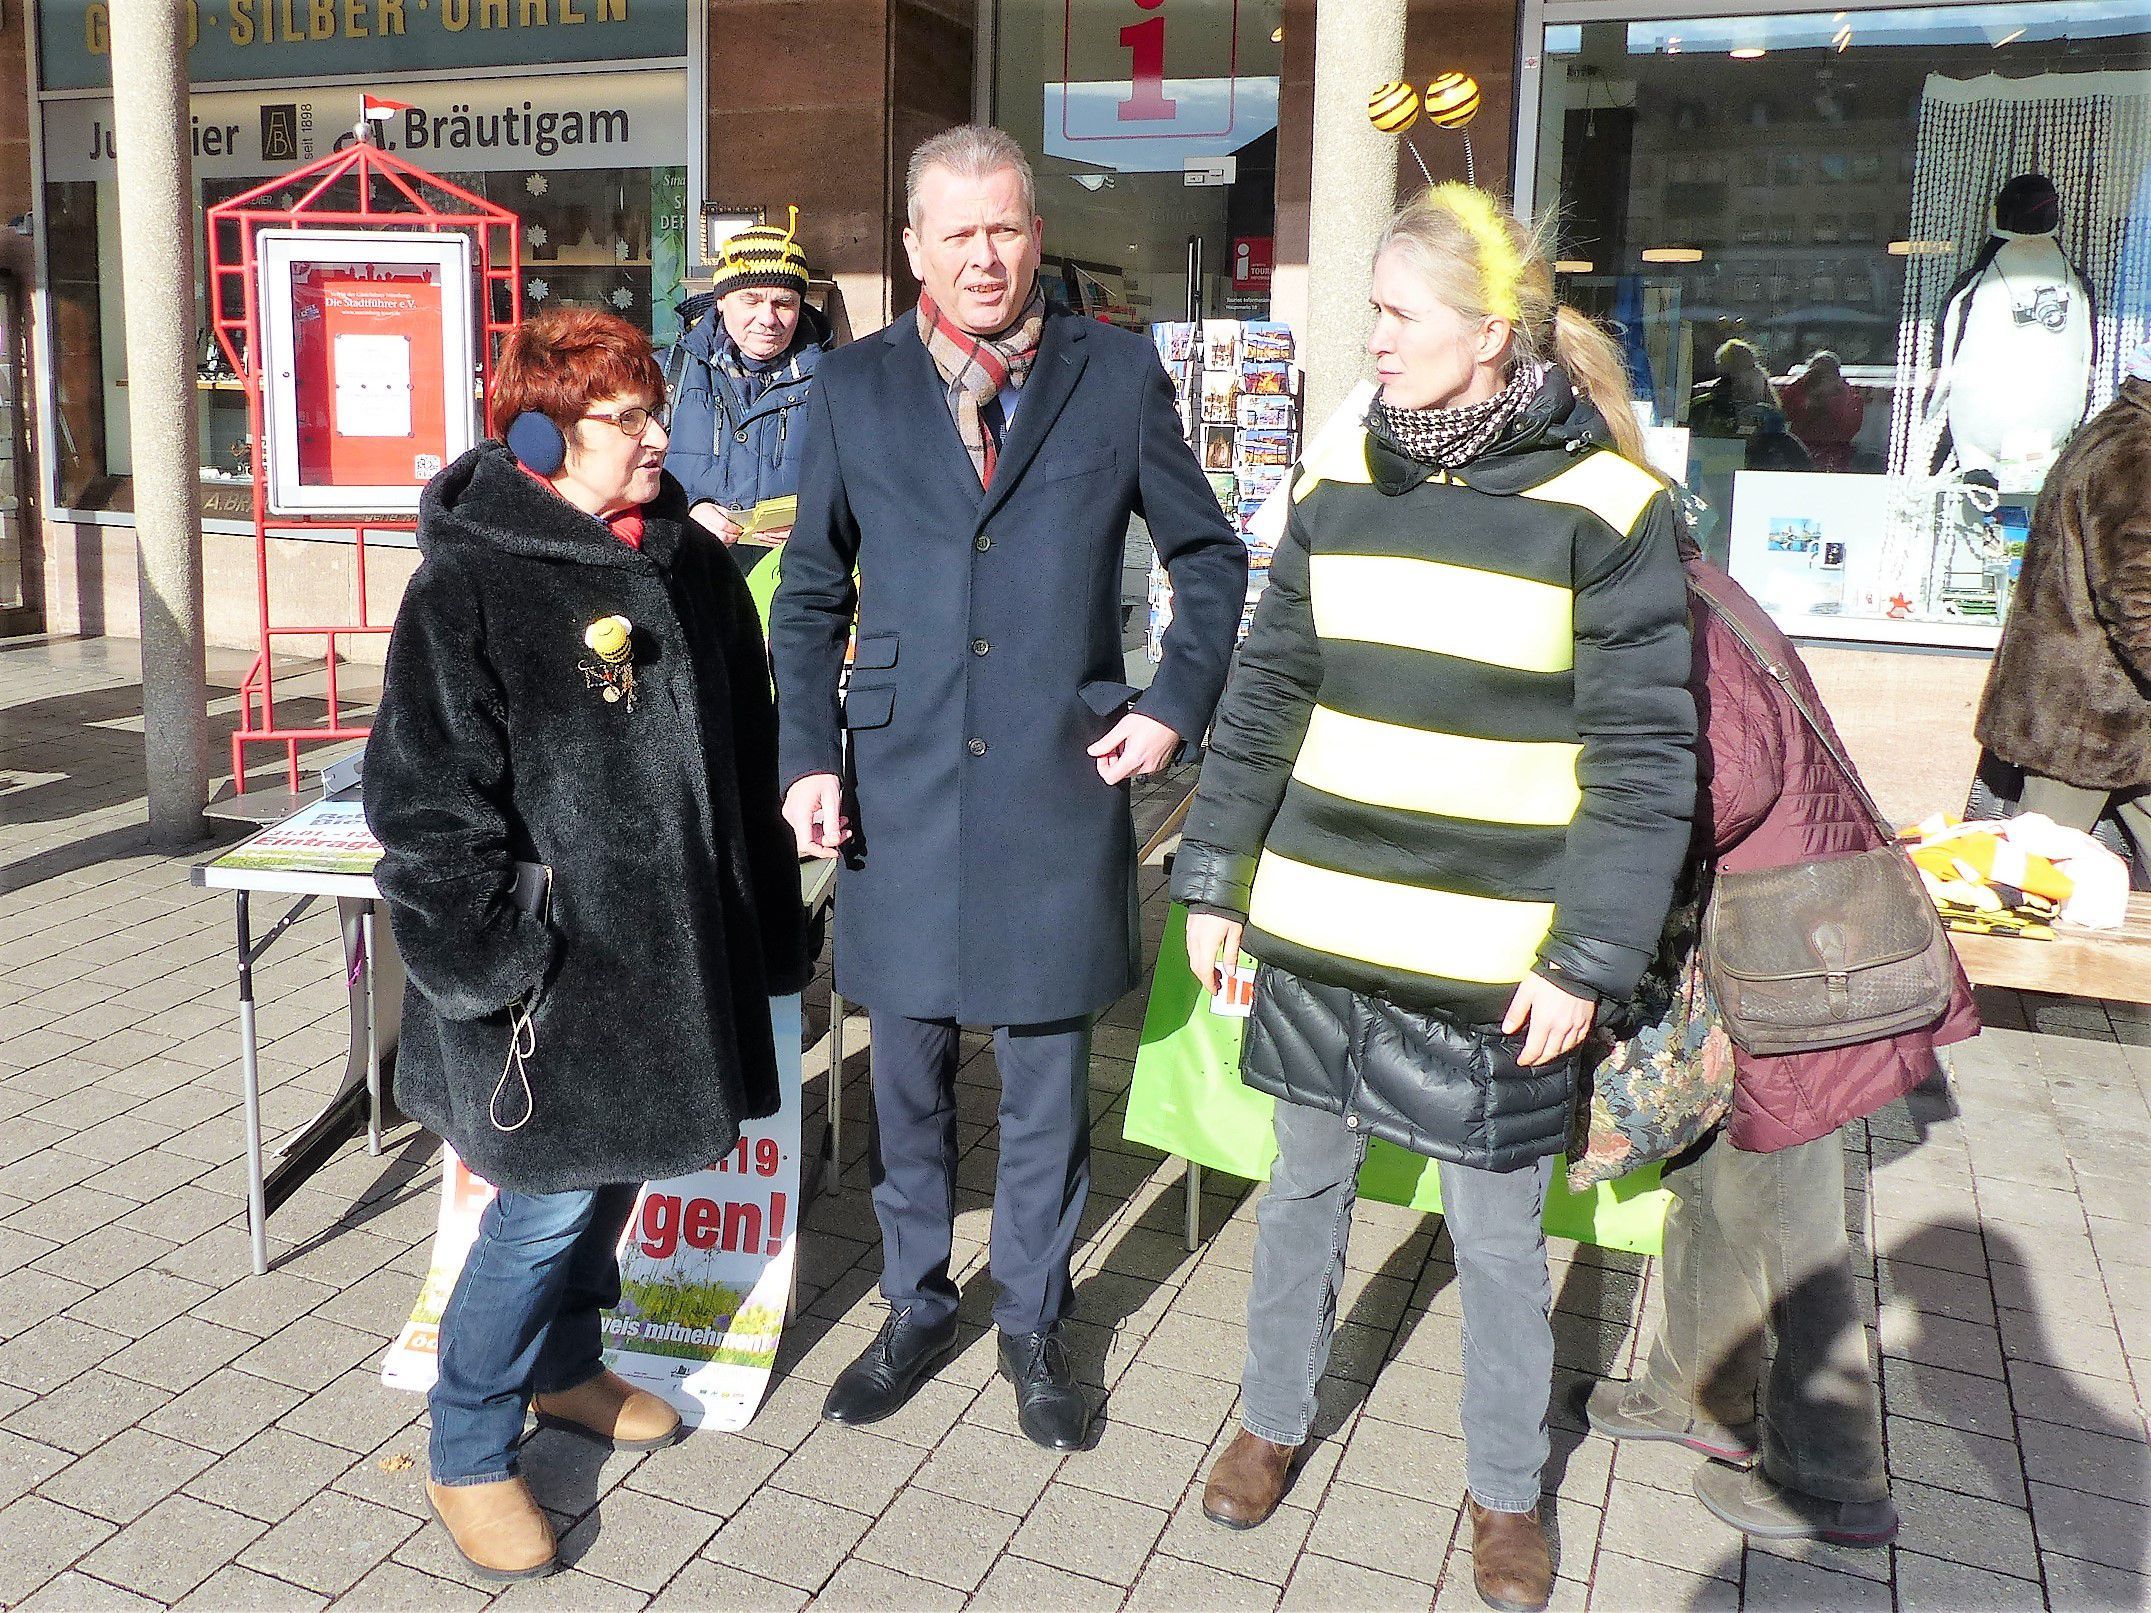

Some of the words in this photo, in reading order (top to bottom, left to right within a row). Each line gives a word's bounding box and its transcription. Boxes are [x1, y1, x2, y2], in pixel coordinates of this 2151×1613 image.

[229, 0, 406, 46] SILBER
[89, 115, 240, 161] Juier
[405, 101, 630, 156] Bräutigam
[300, 103, 314, 134] 1898
[303, 136, 314, 161] seit
